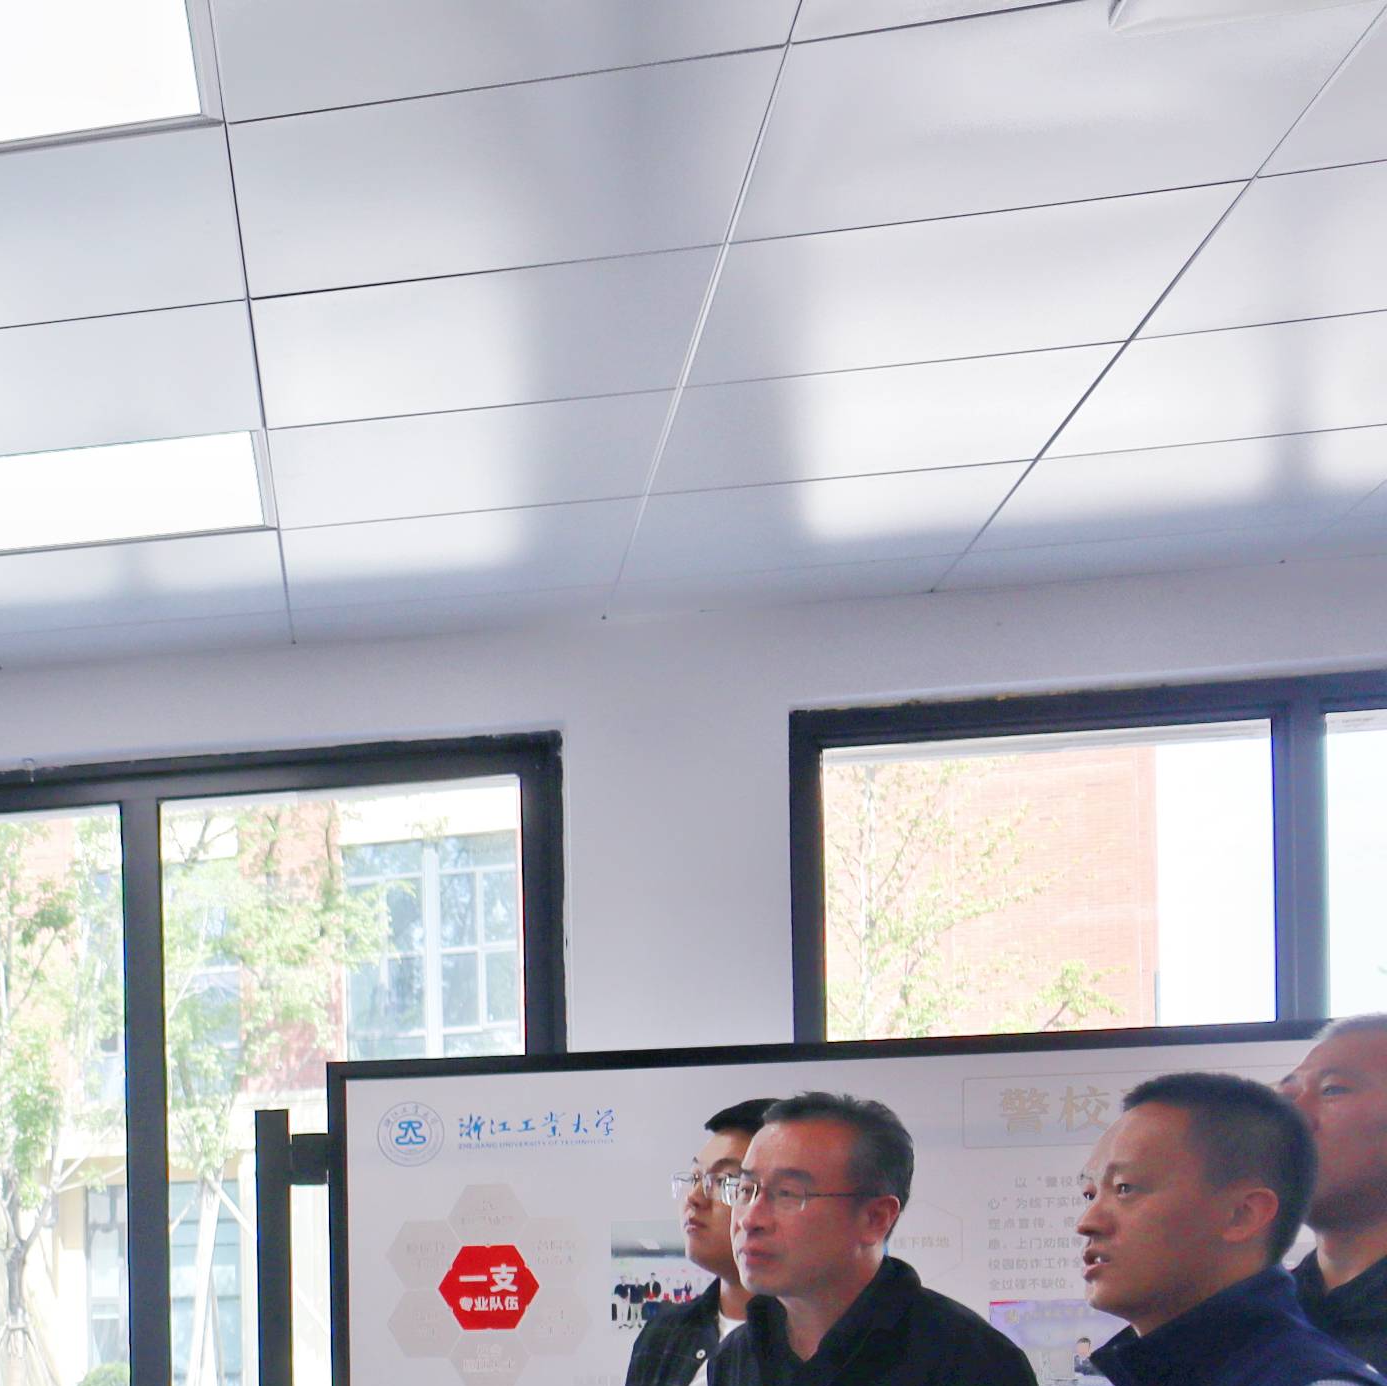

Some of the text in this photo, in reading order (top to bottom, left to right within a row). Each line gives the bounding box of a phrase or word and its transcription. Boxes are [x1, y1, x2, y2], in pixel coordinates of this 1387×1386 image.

[998, 1084, 1125, 1135] 警校
[458, 1263, 518, 1293] 一支
[458, 1296, 519, 1311] 专业队伍
